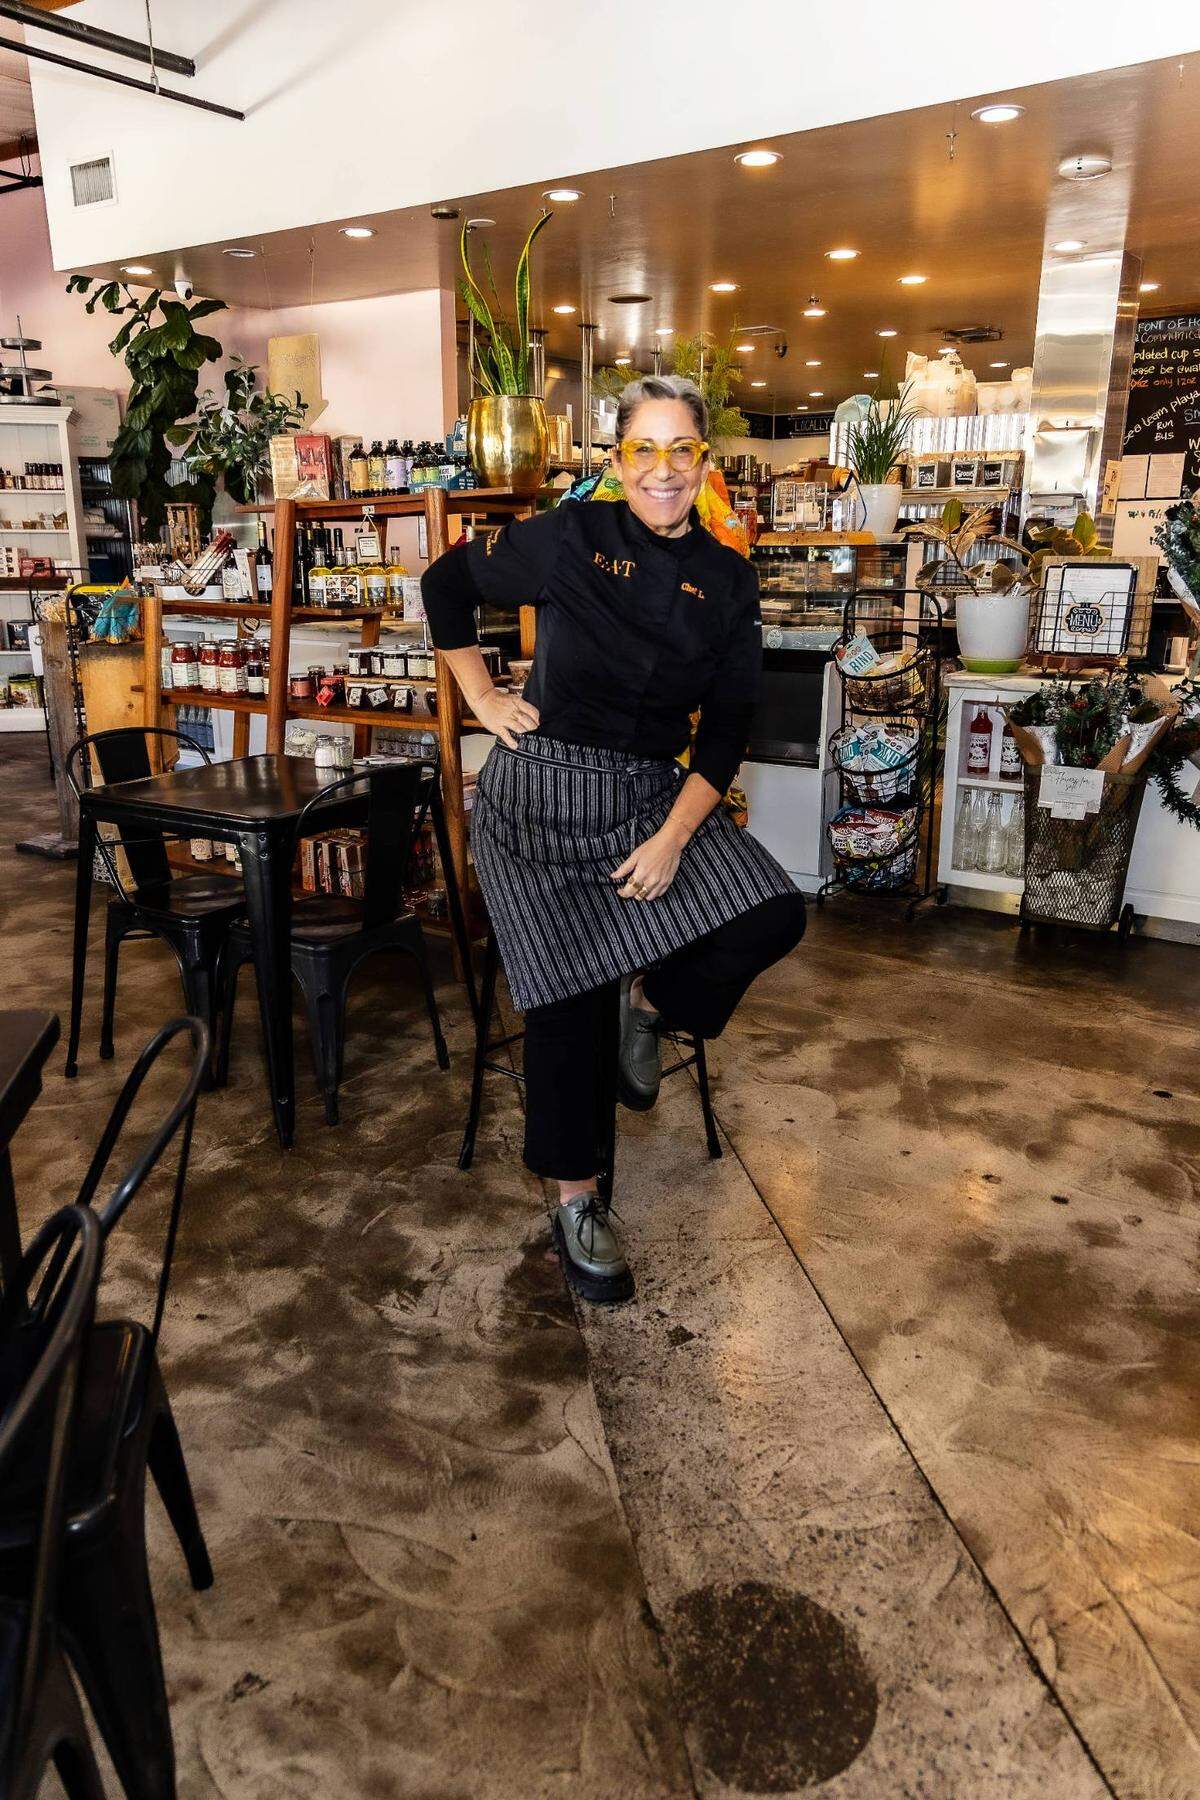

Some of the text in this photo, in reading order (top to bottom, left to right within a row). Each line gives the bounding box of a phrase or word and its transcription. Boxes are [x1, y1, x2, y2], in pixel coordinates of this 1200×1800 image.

[1168, 318, 1186, 330] OF
[1171, 349, 1189, 362] cup
[1160, 364, 1174, 375] be
[1153, 377, 1173, 388] only
[794, 418, 830, 432] LOCALLY
[1069, 613, 1098, 627] MENU
[849, 651, 874, 673] RIND
